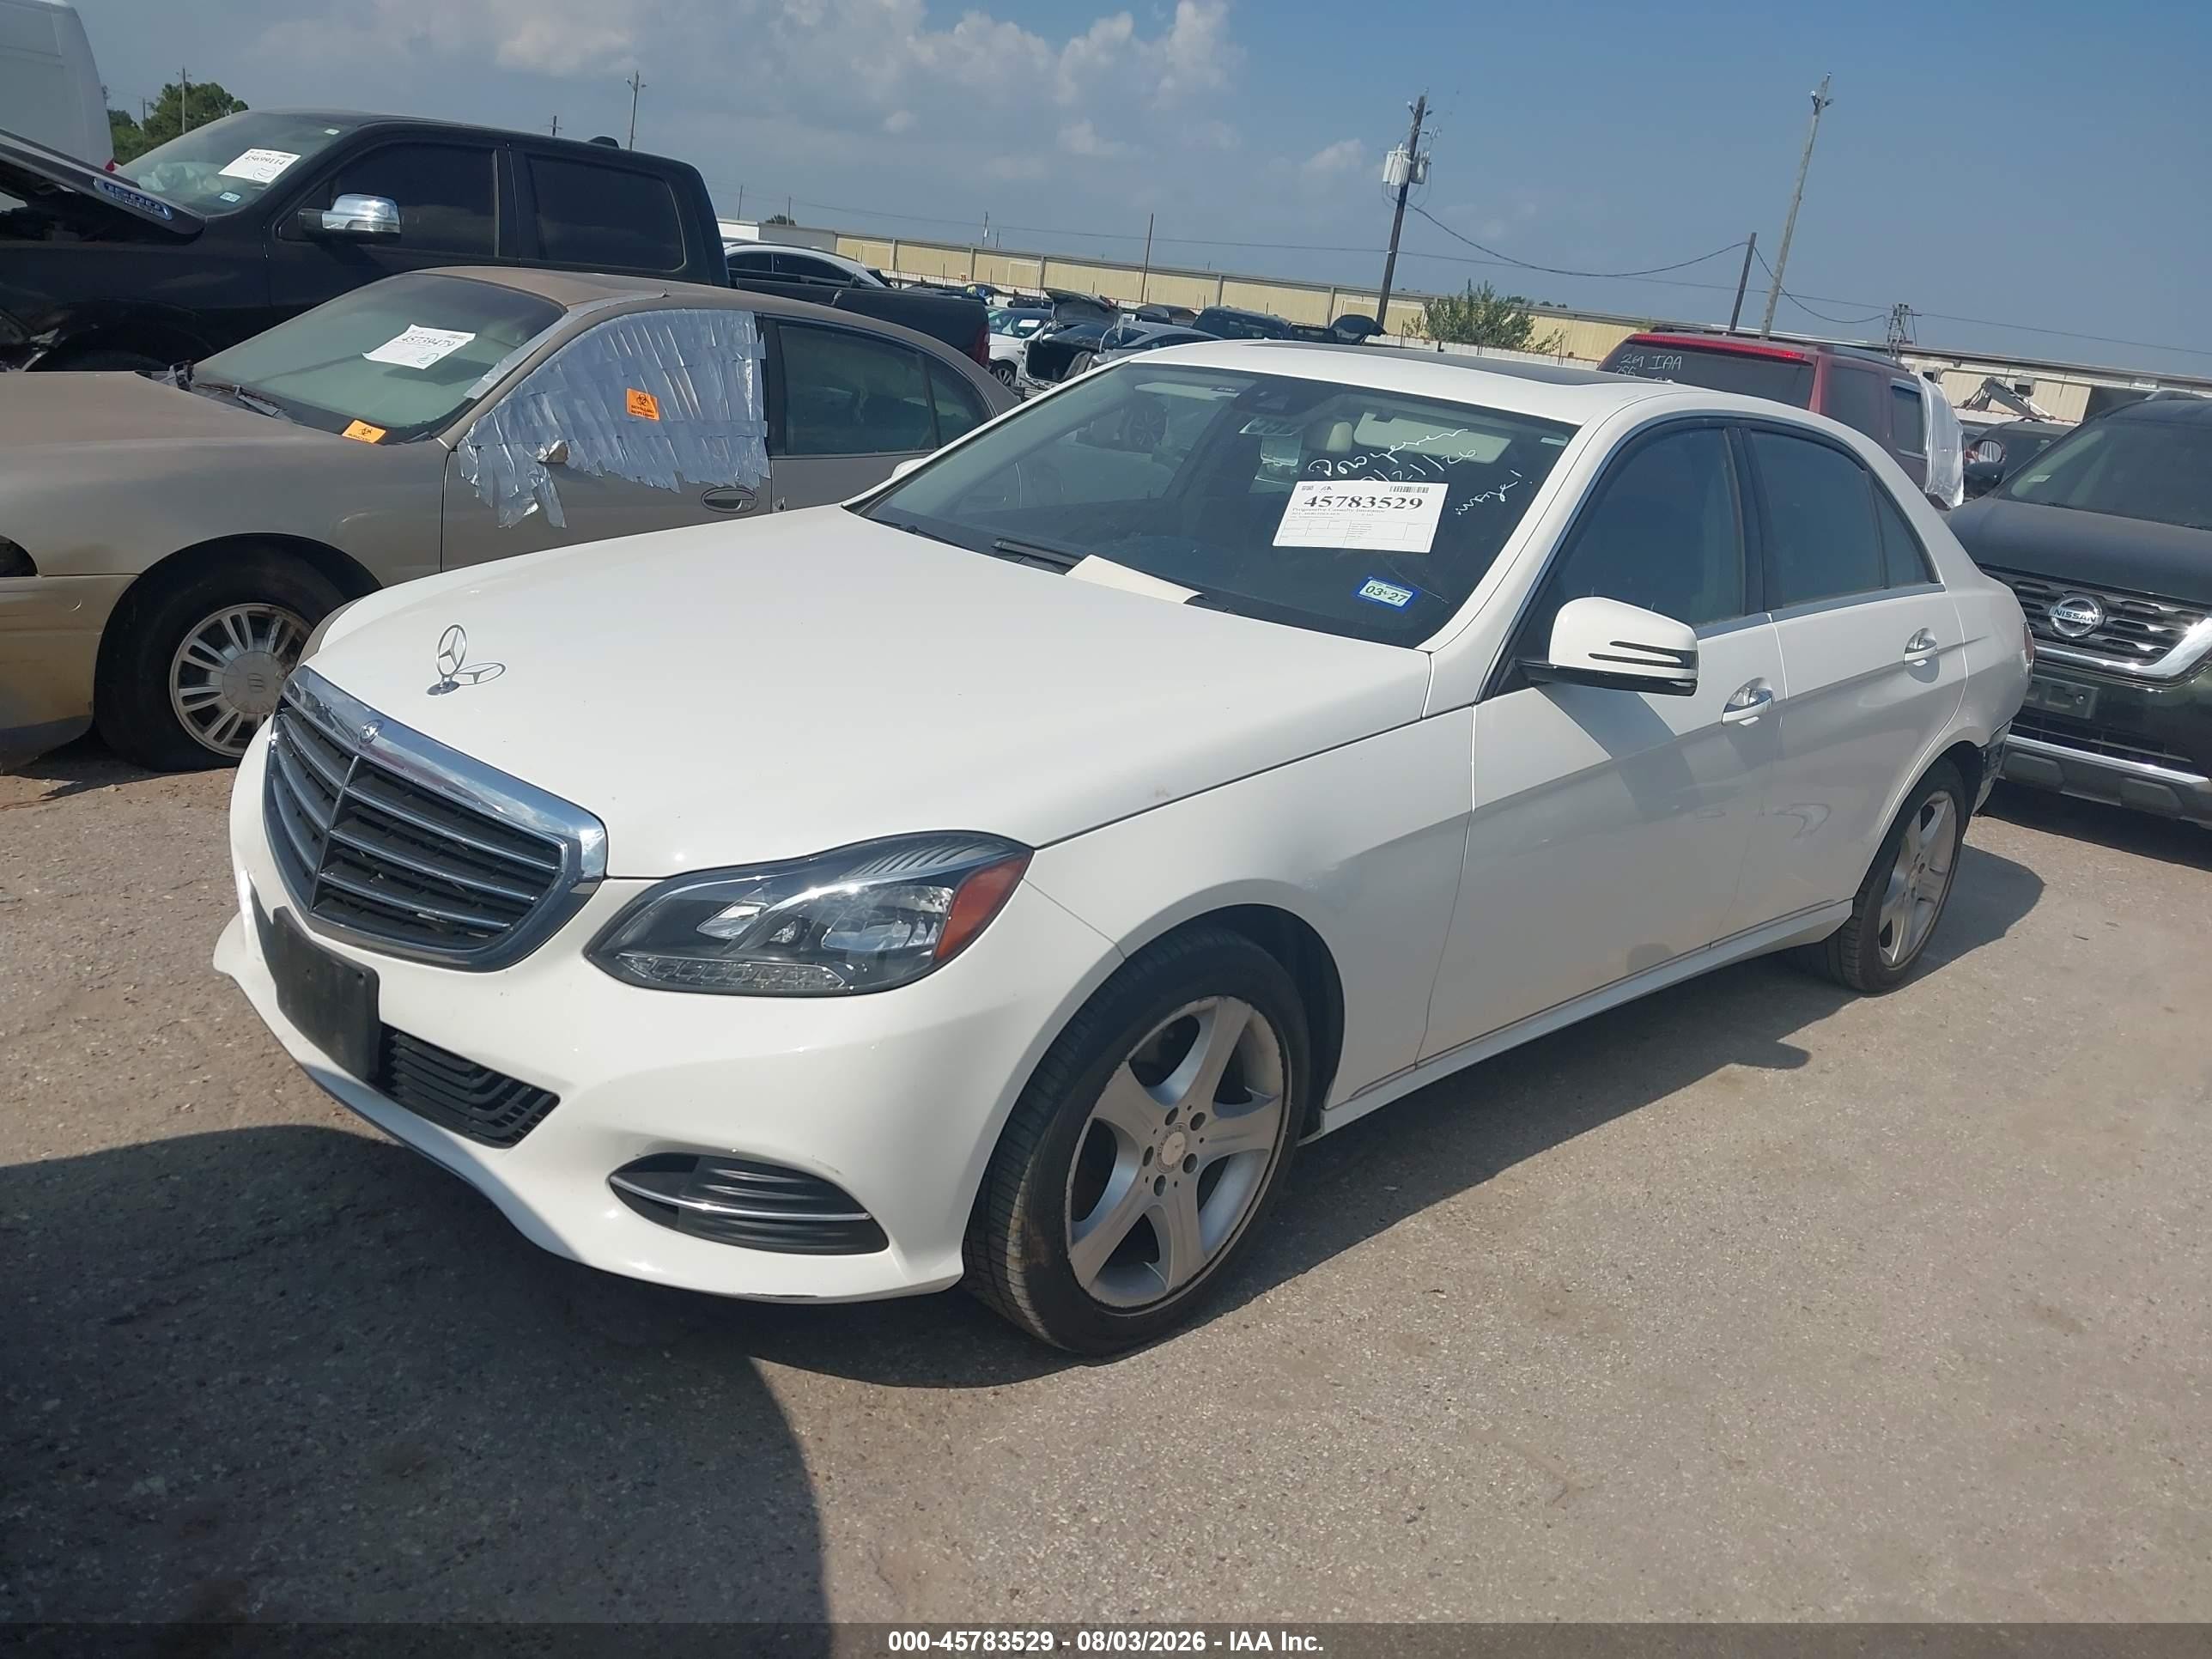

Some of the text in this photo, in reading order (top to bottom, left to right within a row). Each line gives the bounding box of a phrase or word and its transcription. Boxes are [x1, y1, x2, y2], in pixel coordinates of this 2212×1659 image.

[1648, 355, 1682, 370] IAA
[1304, 495, 1423, 510] 45783529
[2054, 609, 2096, 623] NISSAN
